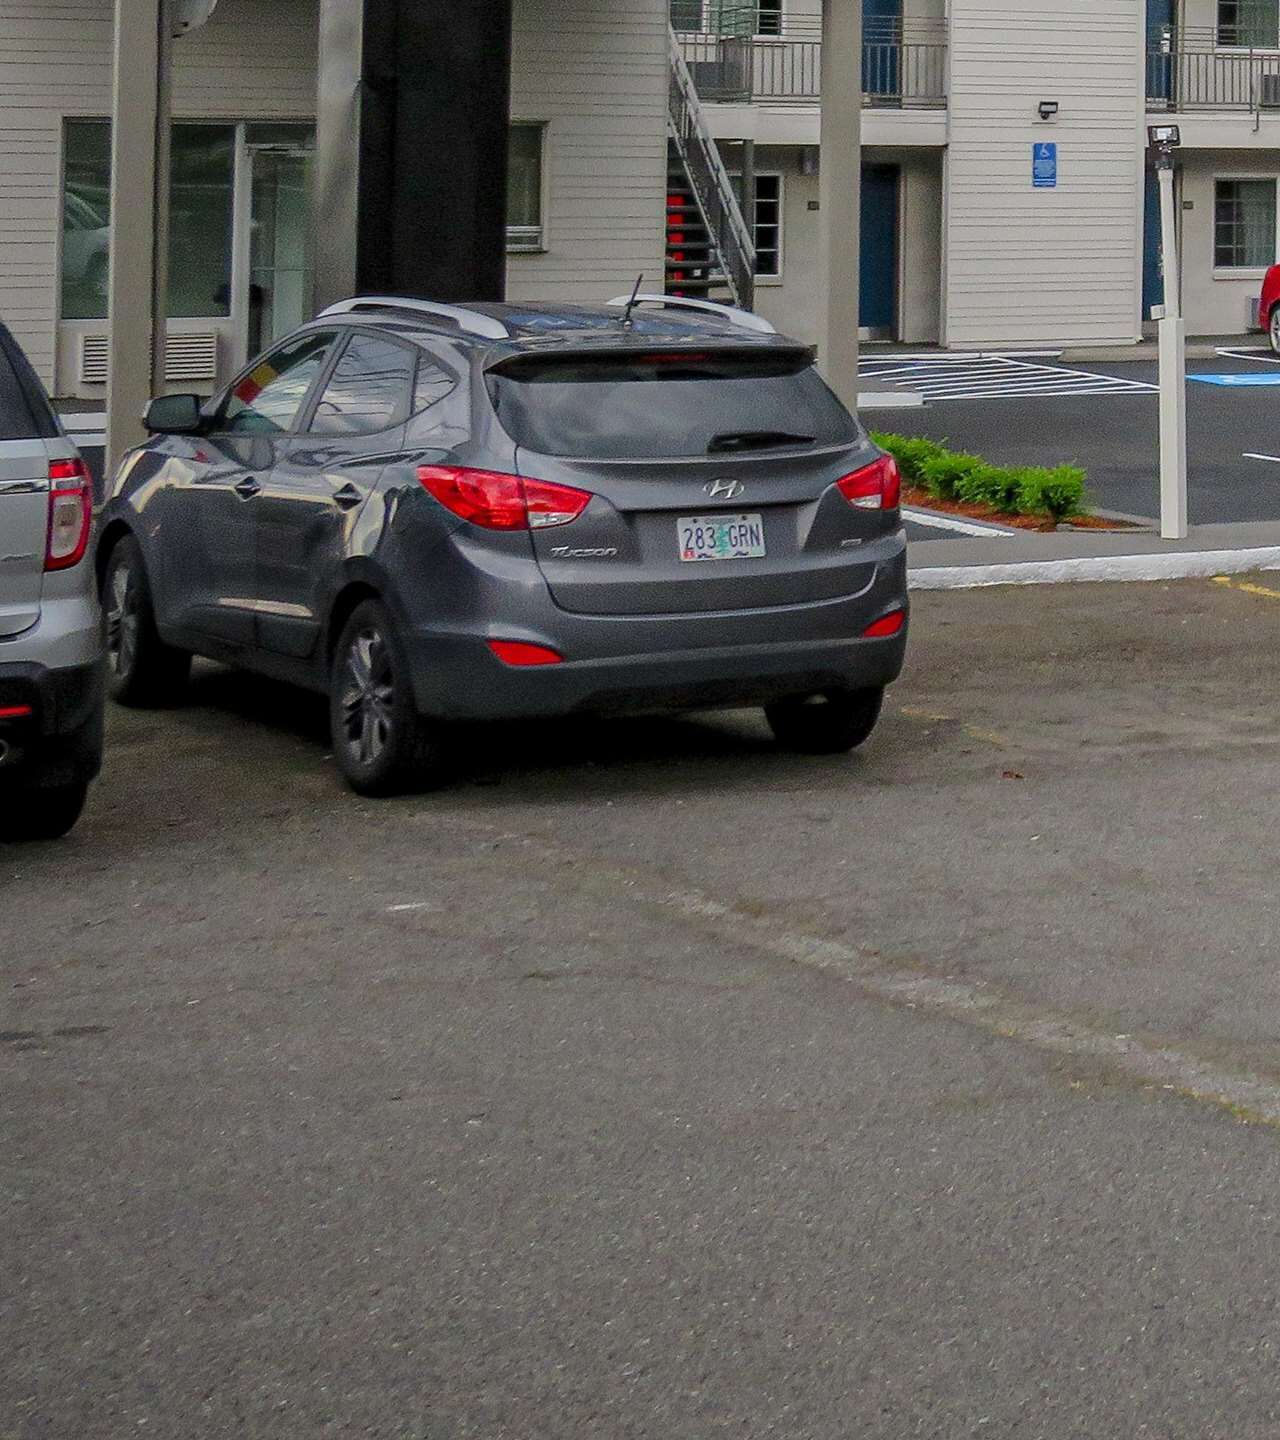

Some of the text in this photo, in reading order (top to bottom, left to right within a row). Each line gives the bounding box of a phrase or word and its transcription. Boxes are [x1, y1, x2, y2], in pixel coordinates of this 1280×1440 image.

[683, 523, 761, 550] 283 GRN
[550, 545, 618, 559] Tucson
